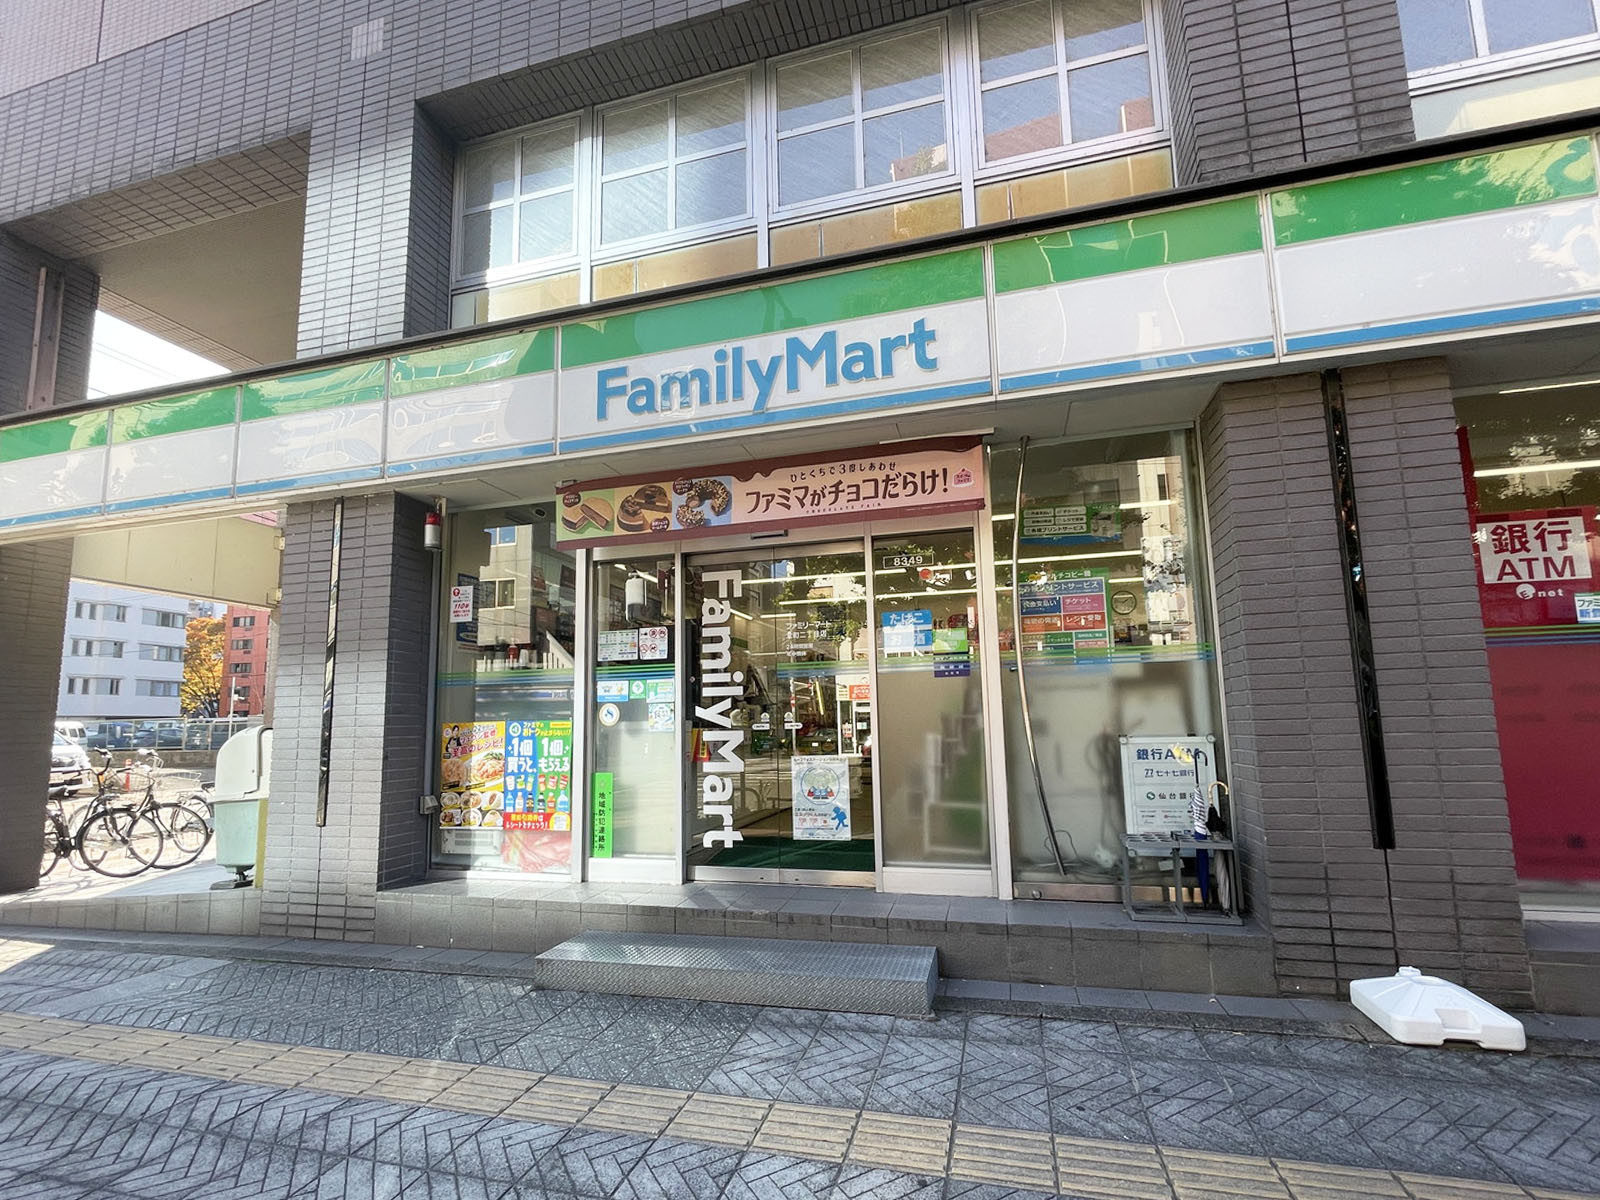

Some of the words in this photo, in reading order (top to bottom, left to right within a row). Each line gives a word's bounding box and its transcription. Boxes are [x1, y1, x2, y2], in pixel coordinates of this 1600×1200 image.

[597, 317, 938, 421] FamilyMart
[790, 461, 897, 483] ひとくちで3度しあわせ
[746, 467, 949, 515] ファミマがチョコだらけ!
[1490, 520, 1572, 555] 銀行
[893, 555, 923, 567] 8349
[1497, 555, 1576, 582] ATM
[1065, 597, 1092, 605] チケット
[786, 620, 832, 630] ファミリーマート
[889, 612, 924, 626] たばこ
[695, 569, 745, 849] FamilyMart
[512, 737, 533, 756] 1個
[541, 737, 563, 756] 1個
[538, 757, 570, 773] もらえる
